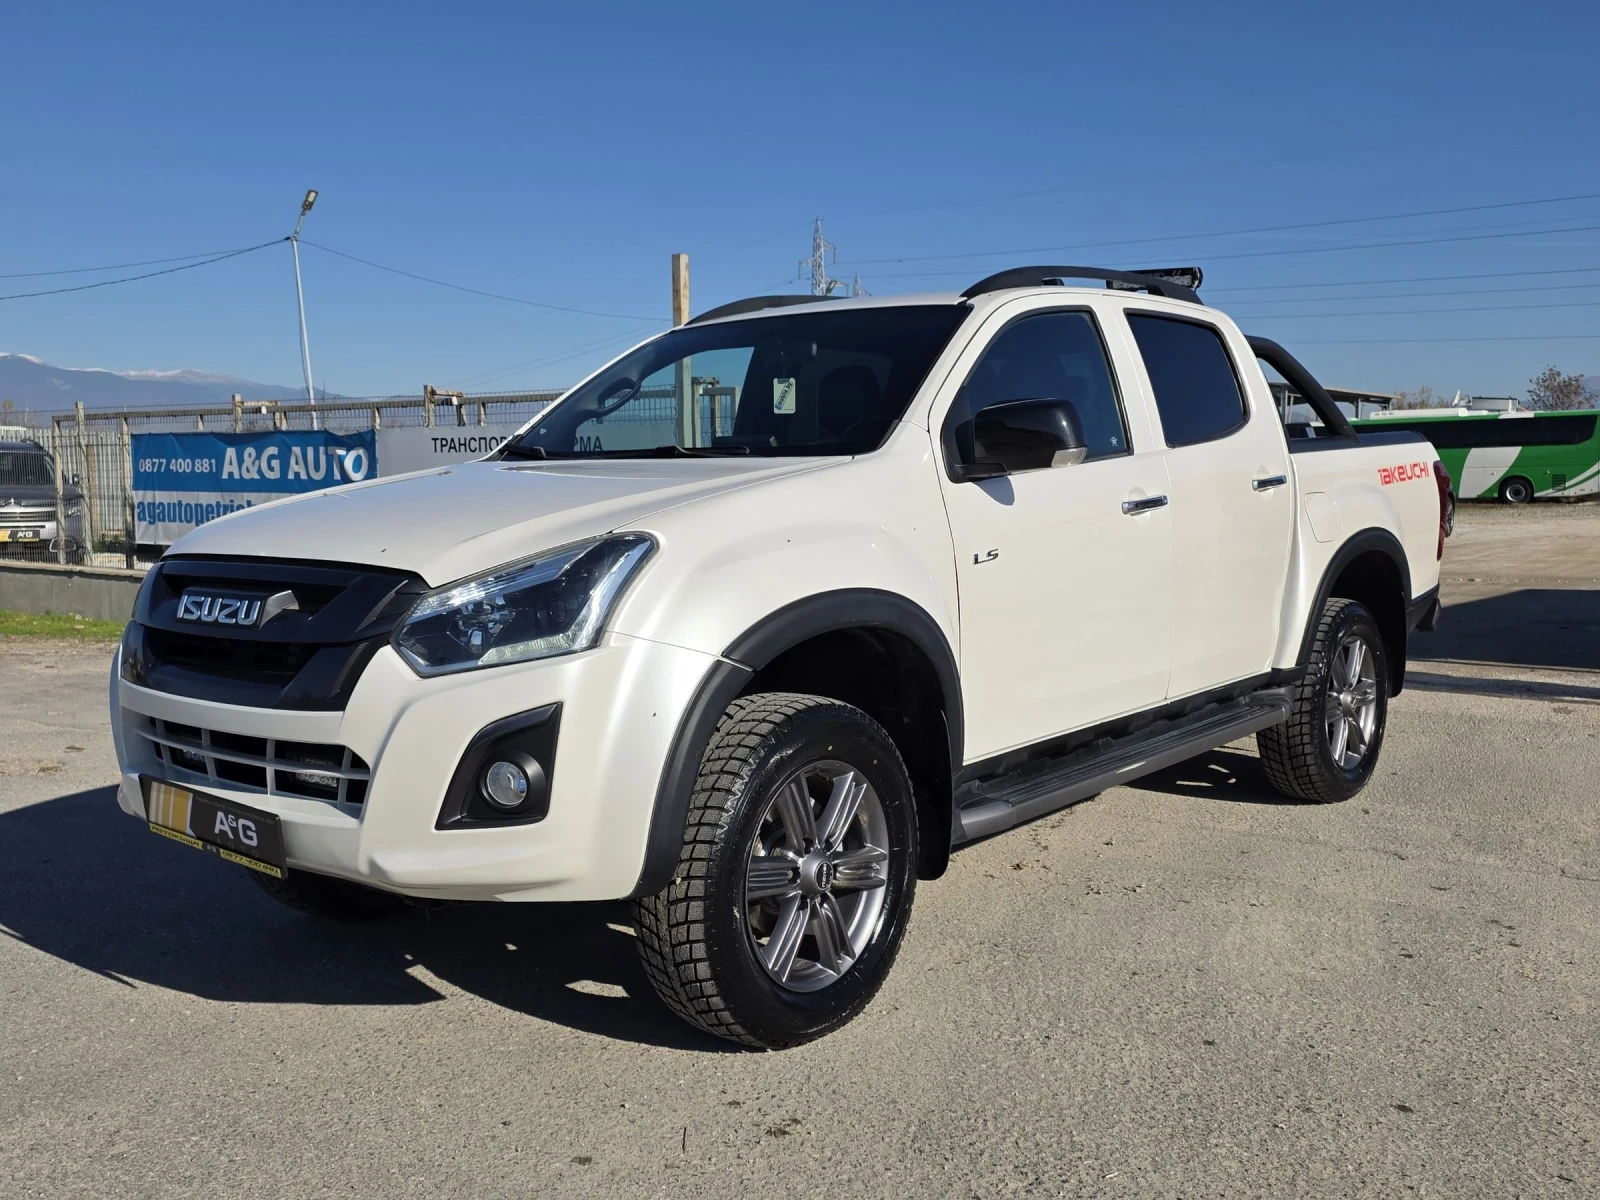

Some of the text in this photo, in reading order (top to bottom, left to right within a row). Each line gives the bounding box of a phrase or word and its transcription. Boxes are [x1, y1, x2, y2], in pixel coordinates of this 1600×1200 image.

[138, 458, 217, 473] 0877 400 881
[221, 446, 369, 482] A&G AUTO
[973, 548, 999, 565] LS
[176, 595, 261, 625] ISUZU
[214, 811, 258, 847] A&G
[222, 850, 279, 875] 0877 400 881
